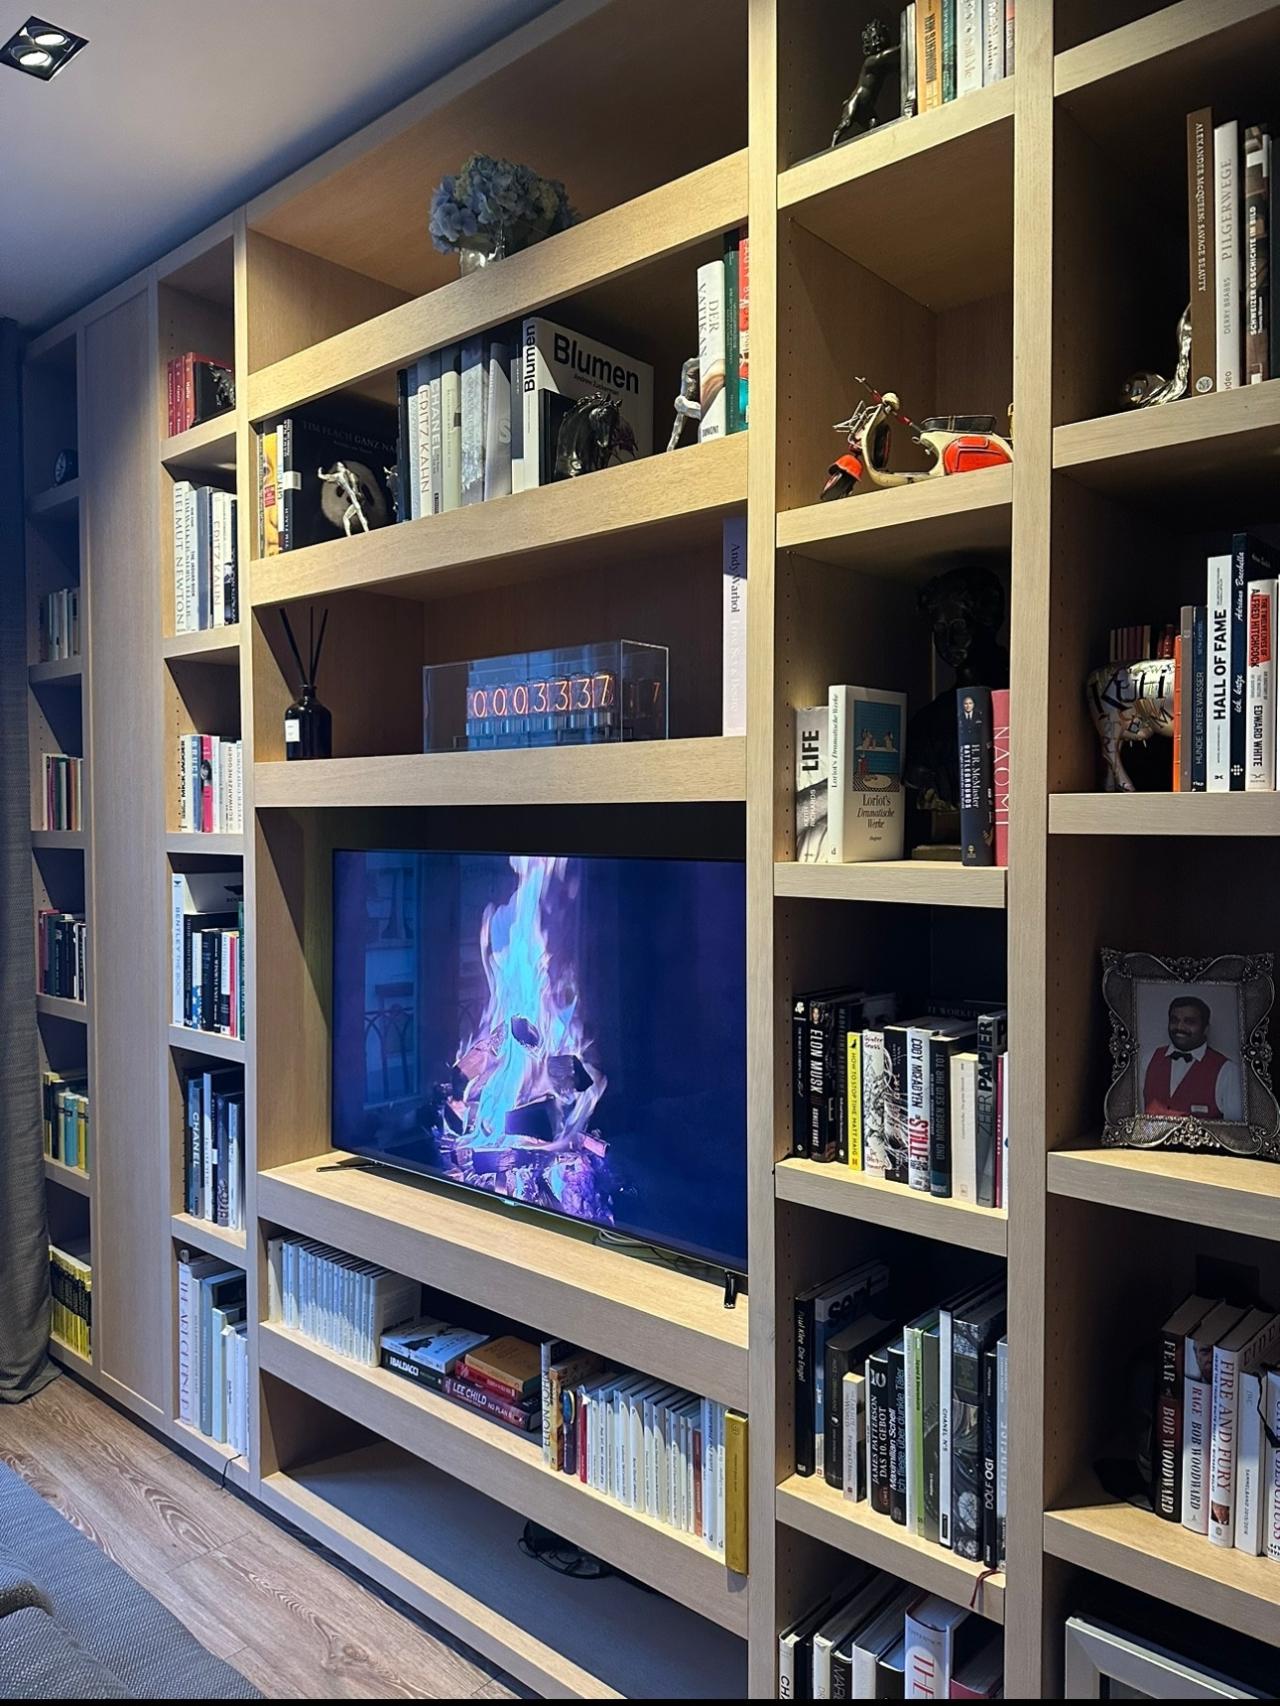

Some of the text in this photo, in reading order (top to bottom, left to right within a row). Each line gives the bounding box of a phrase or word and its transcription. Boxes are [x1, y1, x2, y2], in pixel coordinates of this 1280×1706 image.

[1195, 122, 1205, 176] ALEXANDER
[1219, 158, 1233, 261] PILGERWEGE
[1197, 223, 1206, 256] SAVAGE
[1198, 257, 1206, 292] BEAUTY
[1249, 205, 1257, 336] SCHWEIZER GESCHICHTE IM BILD
[708, 299, 720, 334] DER
[1223, 276, 1231, 335] DERRY BRABBS
[524, 325, 536, 393] Blumen
[553, 332, 640, 395] Blumen
[419, 389, 430, 494] FRITZ KAHN
[430, 380, 441, 456] CHANEL
[175, 487, 185, 626] HELMUT NEWTON
[729, 543, 742, 614] Andy Warhol
[1213, 609, 1227, 652] FAME
[1250, 588, 1261, 668] ALFRED HITCHCOCK
[1260, 597, 1268, 656] THE TWELVE LIVES OF
[1213, 656, 1227, 676] OF
[1195, 671, 1205, 765] HUNDE UNTER WASSER
[1213, 678, 1227, 720] HALL
[191, 740, 199, 780] BRUCE
[802, 729, 820, 772] LIFE
[1252, 705, 1263, 767] EDWARD WHITE
[831, 758, 839, 788] Loriot's
[862, 793, 892, 806] Loriot's
[963, 744, 971, 809] BATTLEGROUNDS
[971, 743, 981, 809] H. R. McMaster
[993, 726, 1010, 825] NAOMI
[856, 808, 895, 819] Dramatische
[867, 818, 885, 829] Werke
[810, 1028, 823, 1094] ELON MUSK
[850, 1070, 857, 1080] TO
[911, 1037, 923, 1109] CODY MCFADYEN
[977, 1020, 992, 1137] ZEER PAPIER
[811, 1107, 819, 1128] ASHLEE
[935, 1052, 945, 1160] UND MORGEN SEID IHR TOT
[192, 1111, 200, 1169] CHANEL
[909, 1117, 928, 1161] STILLE
[798, 1328, 806, 1345] Klee
[798, 1346, 806, 1359] Die
[451, 1382, 487, 1406] LEE CHILD
[797, 1359, 806, 1382] Engel
[487, 1402, 509, 1418] NO PLAN
[543, 1370, 551, 1447] ELTON JOHN
[895, 1367, 906, 1494] Ich fliege über dunkle Täler
[1162, 1339, 1175, 1514] FEAR BOB WOODWARD
[1217, 1358, 1235, 1493] FIRE AND FURY
[871, 1453, 879, 1485] JAMES
[879, 1405, 887, 1478] DAS 10. GEBOT
[888, 1407, 897, 1491] Maximilian Schell
[984, 1458, 994, 1481] OGI
[1190, 1386, 1203, 1510] RAGE BOB WOODWARD
[984, 1480, 994, 1510] DOLF
